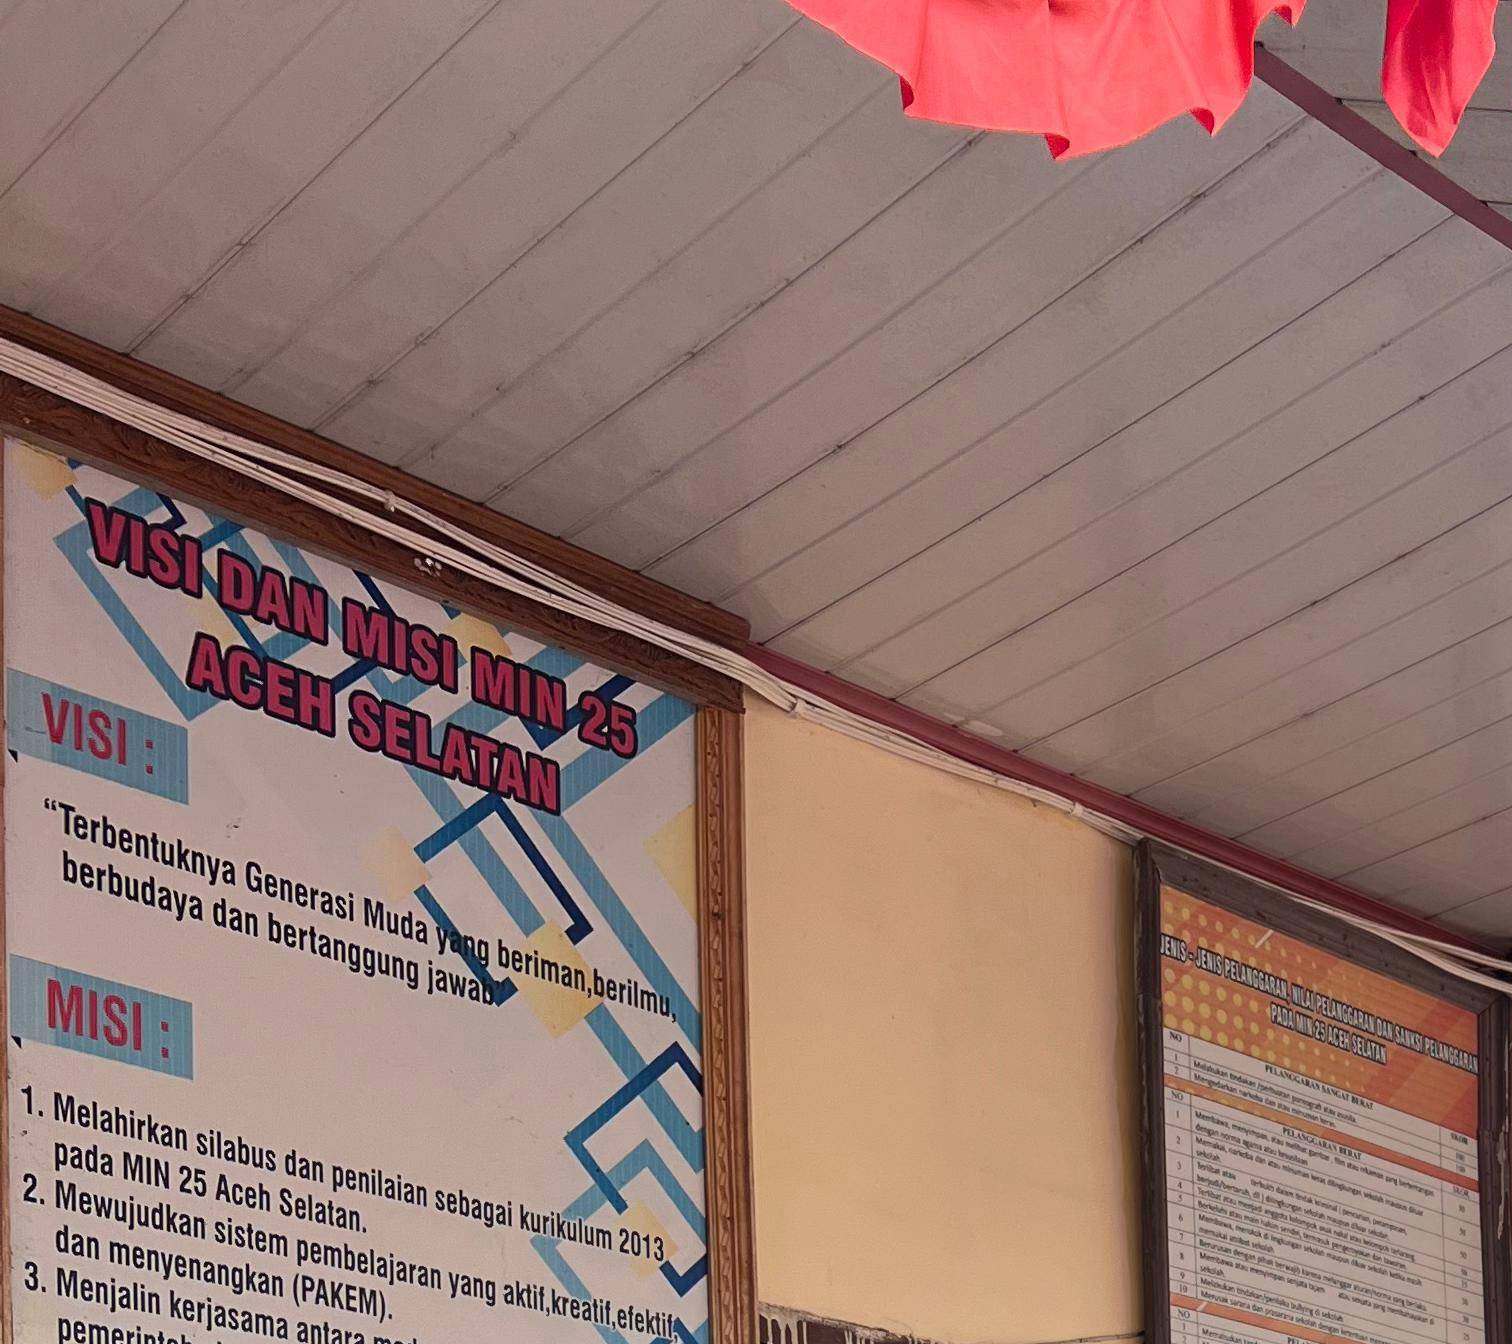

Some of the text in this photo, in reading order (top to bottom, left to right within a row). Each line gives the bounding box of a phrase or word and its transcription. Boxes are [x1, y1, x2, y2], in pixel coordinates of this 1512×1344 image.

[85, 498, 638, 758] VISI DAN MISI MIN 25
[40, 692, 128, 767] VISI
[187, 631, 561, 816] ACEH SELATAN
[61, 851, 205, 927] berbudaya
[212, 897, 260, 940] dan
[267, 915, 421, 988] bertanggung
[244, 863, 357, 922] Generasi
[363, 898, 428, 946] Muda
[435, 920, 490, 968] yang
[46, 979, 144, 1052] MISI
[1160, 934, 1186, 963] JENIS
[1196, 946, 1222, 976] JENIS
[1292, 983, 1314, 1012] NILAI
[1315, 991, 1375, 1034] PELANGGARAN
[1377, 1017, 1392, 1040] DAN
[1424, 1036, 1479, 1074] PELANGGARAN
[1271, 1002, 1387, 1065] PADA MIN 25 ACEH SELATAN
[20, 1085, 665, 1262] 1. Melahirkan silabus dan penilaian sebagai kurikulum 2013
[54, 1142, 367, 1233] pada MIN 25 Aceh Selatan.
[22, 1173, 45, 1205] 2.
[55, 1180, 206, 1240] Mewujudkan
[214, 1218, 288, 1257] sistem
[296, 1239, 442, 1290] pembelajaran
[448, 1271, 497, 1307] yang
[55, 1225, 393, 1323] dan menyenangkan (PAKEM).
[24, 1261, 47, 1293] 3.
[57, 1268, 161, 1315] Menjalin
[169, 1290, 288, 1340] kerjasama
